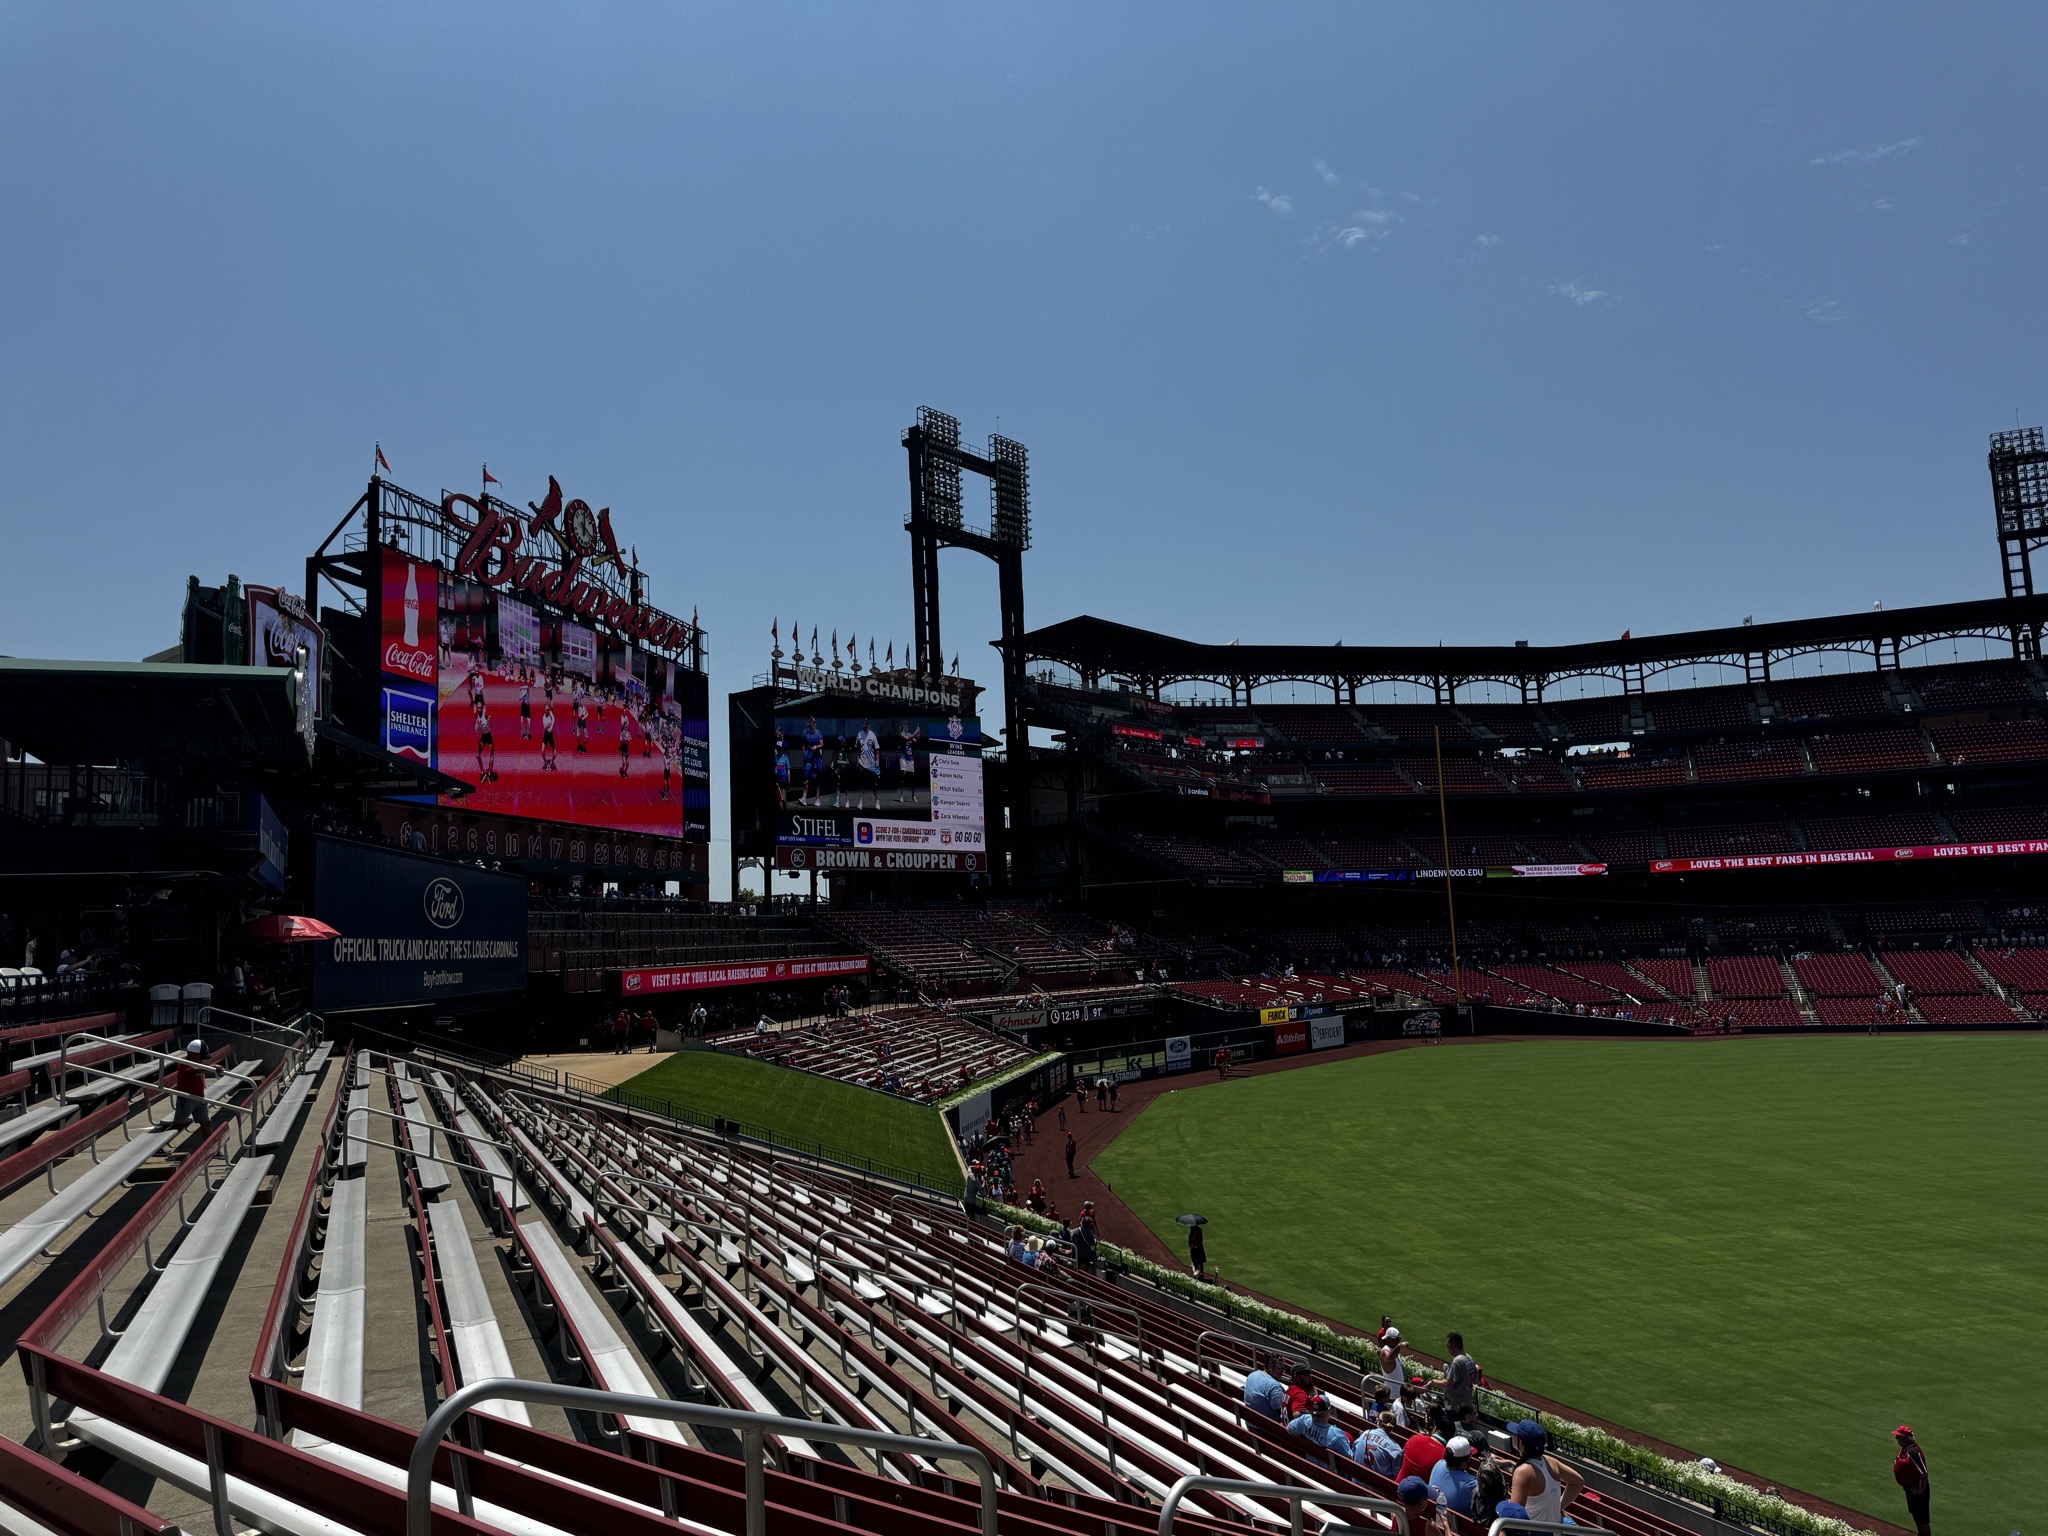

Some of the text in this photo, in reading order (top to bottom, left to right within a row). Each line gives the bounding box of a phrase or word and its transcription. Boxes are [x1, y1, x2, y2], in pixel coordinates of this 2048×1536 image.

[445, 493, 688, 651] Budweiser
[386, 642, 436, 678] Coca-Cola
[796, 666, 961, 708] WORLD CHAMPIONS
[390, 709, 428, 729] SHELTER
[390, 722, 427, 737] INSURANCE
[683, 735, 708, 749] PROUD PART
[684, 746, 699, 757] OF THE
[690, 758, 703, 768] LOUIS
[684, 767, 709, 780] COMMUNITY
[792, 814, 840, 837] STIFEL
[901, 827, 922, 835] CARDINALS
[922, 828, 936, 836] TICKETS
[954, 831, 963, 842] GO
[964, 832, 972, 843] GO
[973, 832, 982, 843] GO
[431, 824, 439, 851] 1
[447, 825, 459, 852] 2
[466, 827, 478, 853] 6
[486, 830, 497, 855] 9
[505, 832, 520, 858] 10
[527, 835, 542, 859] 14
[549, 838, 563, 860] 17
[569, 840, 586, 863] 20
[594, 843, 609, 865] 23
[614, 844, 629, 866] 24
[634, 846, 649, 868] 42
[653, 849, 667, 869] 45
[669, 850, 683, 870] 85
[1690, 860, 1721, 869] LOVES
[1724, 859, 1744, 867] THE
[1747, 857, 1773, 866] BEST
[1776, 855, 1803, 865] FANS
[1805, 854, 1817, 864] IN
[1820, 851, 1874, 863] BASEBALL
[1933, 847, 1968, 857] LOVES
[1971, 846, 1994, 855] THE
[1996, 843, 2026, 854] BEST
[815, 850, 870, 868] BROWN
[873, 855, 883, 867] &
[1416, 869, 1483, 878] LINDENWOOD.EDU
[431, 883, 458, 920] Ford
[333, 938, 519, 963] OFFICIAL TRUCK AND CAR OF THE ST. LOUIS CARDINALS
[423, 969, 463, 989] BuyFordNow.com
[651, 974, 671, 988] VISIT
[671, 973, 681, 985] US
[681, 973, 690, 985] AT
[691, 972, 708, 984] YOUR
[708, 970, 727, 983] LOCAL
[727, 968, 750, 981] RAISING
[791, 964, 802, 975] VISIT
[802, 963, 810, 974] US
[810, 963, 817, 973] AT
[816, 962, 828, 973] YOUR
[828, 961, 840, 972] LOCAL
[840, 961, 855, 971] RAISING
[1062, 1010, 1080, 1021] 12:19
[1267, 1010, 1286, 1021] FABICK
[1114, 1069, 1142, 1081] STADIUM
